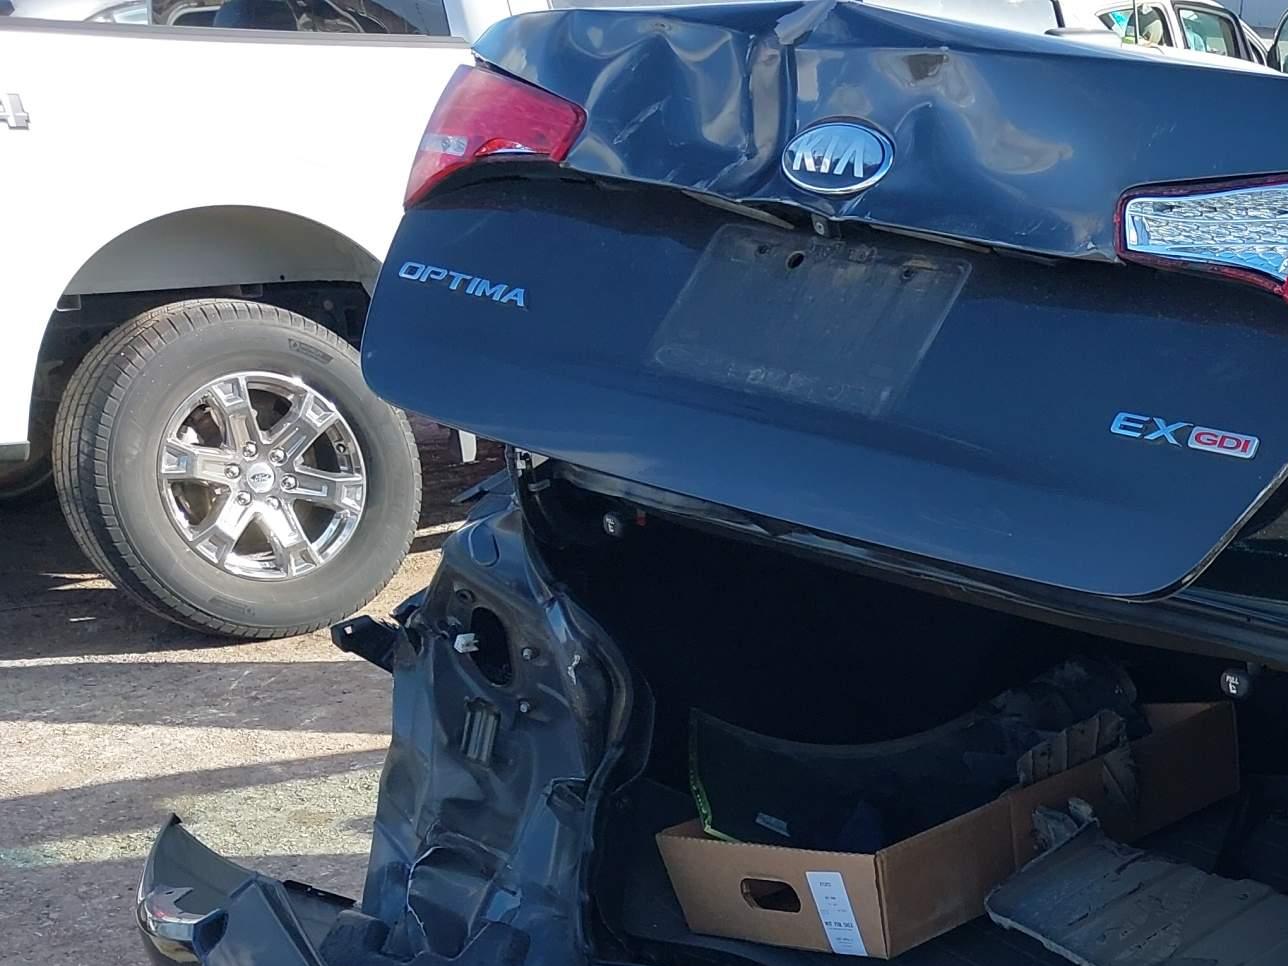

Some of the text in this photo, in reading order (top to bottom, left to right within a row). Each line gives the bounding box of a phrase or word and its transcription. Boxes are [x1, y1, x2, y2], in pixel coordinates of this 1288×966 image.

[792, 133, 865, 178] KIA
[399, 261, 525, 307] OPTIMA
[1110, 411, 1251, 453] EX GDI
